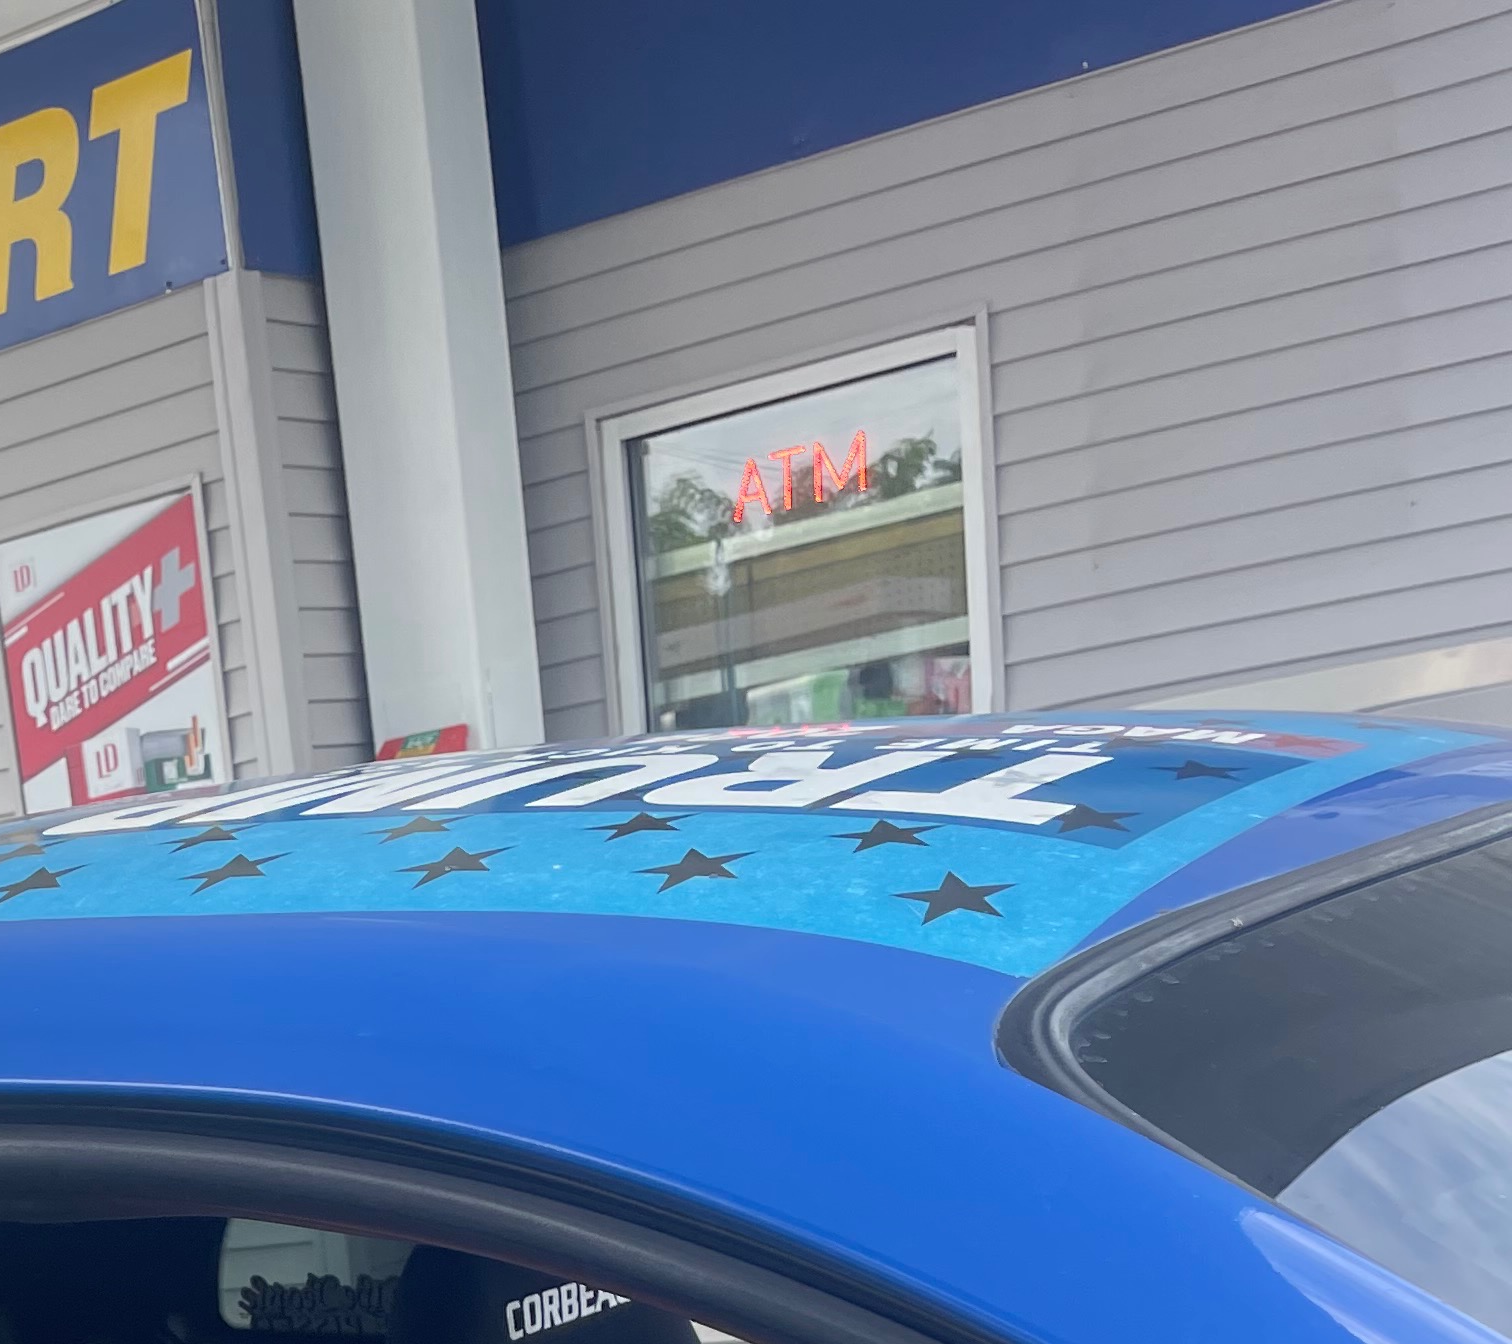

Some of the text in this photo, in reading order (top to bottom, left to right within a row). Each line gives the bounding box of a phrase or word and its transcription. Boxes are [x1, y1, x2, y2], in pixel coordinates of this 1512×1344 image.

[732, 429, 869, 524] ATM
[49, 638, 158, 732] DARE TO COMPARE
[873, 737, 1108, 753] TIME
[1001, 723, 1268, 745] MAGA
[41, 750, 1115, 837] TRUMP
[506, 1281, 632, 1341] CORBEA
